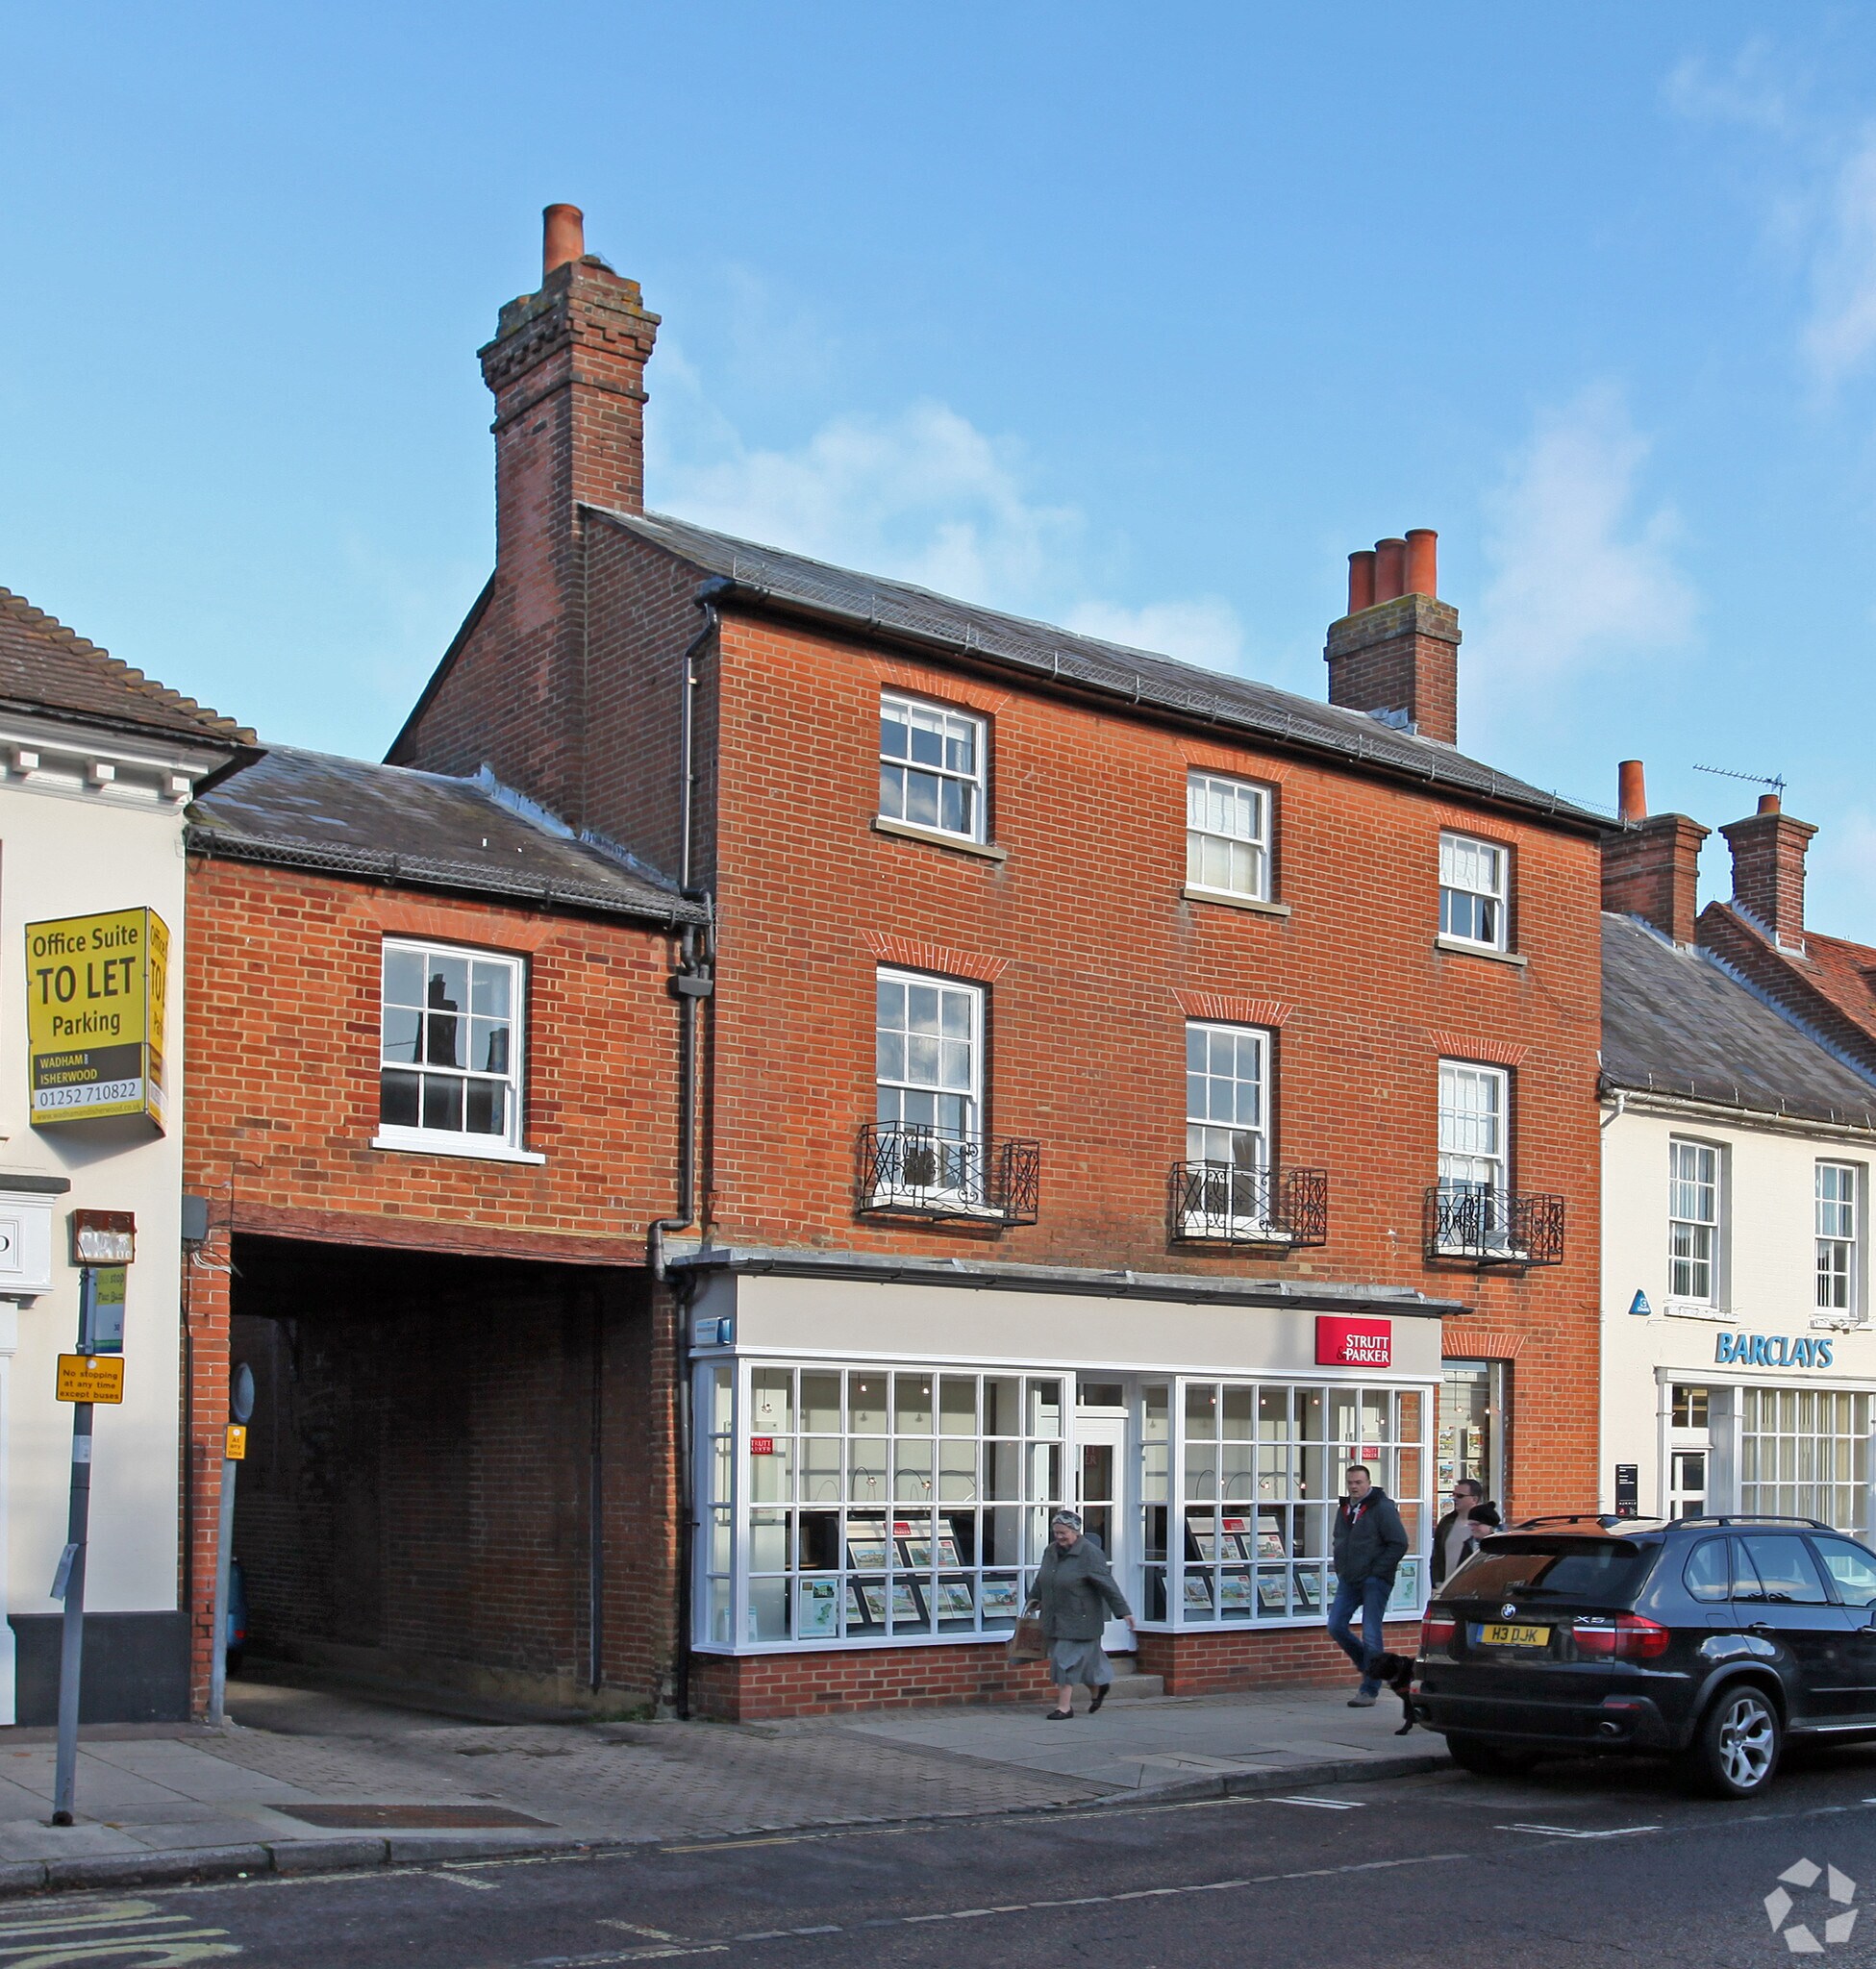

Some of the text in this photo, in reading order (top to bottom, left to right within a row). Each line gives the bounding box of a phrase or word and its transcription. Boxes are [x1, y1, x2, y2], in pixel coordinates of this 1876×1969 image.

[33, 925, 138, 957] Office Suite
[37, 964, 76, 1005] TO
[87, 957, 136, 999] LET
[53, 1009, 120, 1036] Parking
[39, 1055, 83, 1069] WADHAM
[40, 1068, 97, 1084] ISHERWOOD
[39, 1088, 82, 1107] 01252
[87, 1082, 136, 1102] 710822
[1346, 1334, 1388, 1349] STRUTT
[1343, 1348, 1389, 1362] PARKER
[1714, 1333, 1833, 1368] BARCLAYS
[80, 1370, 118, 1381] stopping
[1573, 1615, 1606, 1624] X5
[1491, 1627, 1538, 1642] H3 DJK
